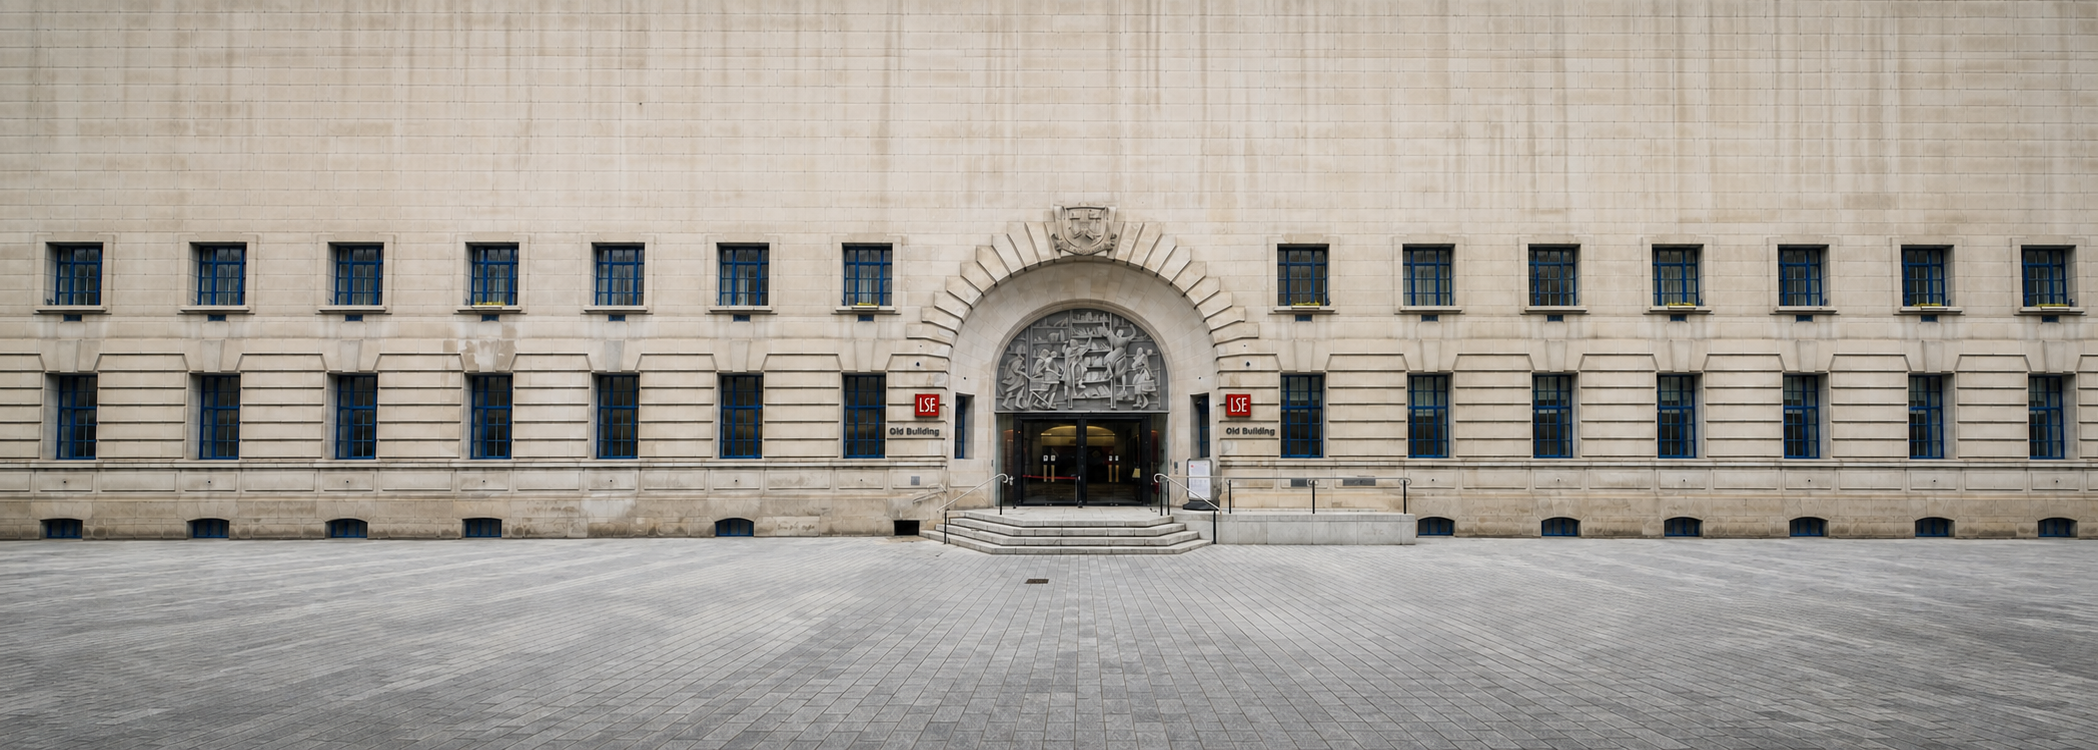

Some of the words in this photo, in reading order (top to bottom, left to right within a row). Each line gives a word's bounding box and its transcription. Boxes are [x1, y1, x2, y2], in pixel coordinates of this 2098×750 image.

[919, 397, 936, 413] LSE
[1230, 397, 1248, 413] LSE
[889, 427, 904, 435] Old
[906, 427, 940, 437] Building
[1226, 427, 1240, 435] Old
[1242, 427, 1276, 437] Building
